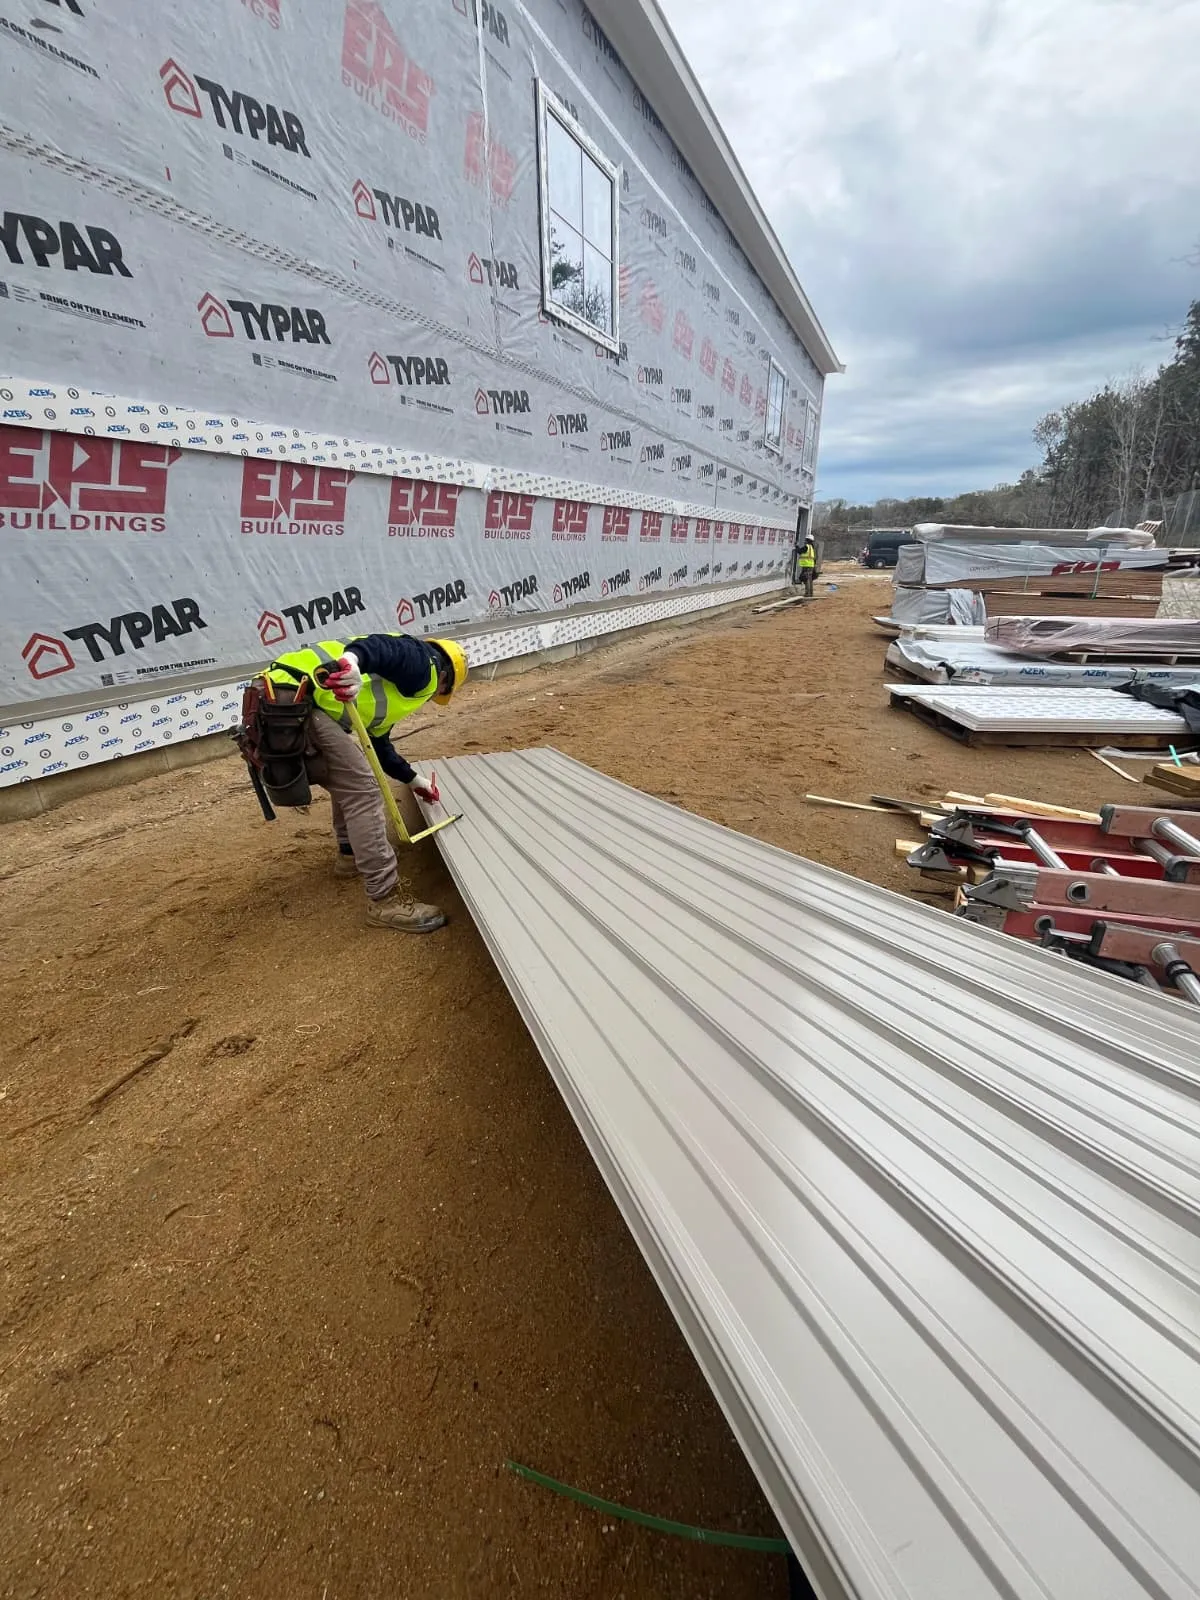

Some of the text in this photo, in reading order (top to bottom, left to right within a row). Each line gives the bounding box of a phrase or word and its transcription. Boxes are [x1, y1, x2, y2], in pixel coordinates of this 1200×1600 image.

[472, 0, 510, 48] PAR
[193, 73, 311, 158] TYPAR
[341, 69, 427, 146] BUILDINGS
[372, 188, 443, 241] TYPAR
[0, 211, 134, 278] YPAR
[481, 258, 520, 291] TPAR
[40, 292, 69, 307] BRING
[70, 300, 84, 312] ON
[84, 305, 101, 317] THE
[227, 299, 331, 345] TYPAR
[386, 355, 451, 385] TYPAR
[644, 367, 664, 385] TYPAR
[28, 388, 52, 397] AZEK
[70, 407, 91, 415] AZEK
[127, 405, 145, 413] AZEK
[487, 390, 531, 414] TYPAR
[3, 410, 28, 418] AZEK
[205, 419, 221, 427] AZEK
[107, 425, 126, 433] AZEK
[157, 421, 175, 429] AZEK
[557, 413, 588, 435] TYPAR
[607, 430, 631, 450] TYPAR
[646, 443, 664, 461] TYPAR
[0, 423, 182, 513] EPS
[240, 457, 356, 521] EPS
[388, 476, 463, 526] EPS
[485, 490, 538, 530] EPS
[0, 512, 166, 532] UILDINGS
[552, 499, 591, 533] EPS
[602, 506, 632, 535] EPS
[241, 521, 344, 536] BUILDINGS
[388, 526, 455, 538] BUILDINGS
[484, 530, 531, 540] BUILDINGS
[561, 571, 590, 598] TYPAR
[608, 569, 630, 592] TYPAR
[412, 579, 467, 618] TYPAR
[500, 574, 539, 606] TYPAR
[281, 586, 366, 635] TYPAR
[63, 597, 208, 662] TYPAR
[137, 667, 159, 675] BRING
[1020, 667, 1045, 675] AZEK
[1082, 669, 1108, 677] AZEK
[167, 695, 184, 705] AZEK
[195, 698, 211, 708] AZEK
[85, 709, 105, 721] AZEK
[120, 712, 139, 724] AZEK
[151, 716, 170, 727] AZEK
[179, 719, 195, 730] AZEK
[24, 731, 48, 745] AZEK
[64, 734, 86, 747] AZEK
[101, 736, 120, 749] AZEK
[134, 738, 153, 751] AZEK
[0, 759, 24, 773] AZEK
[42, 760, 65, 774] AZEK
